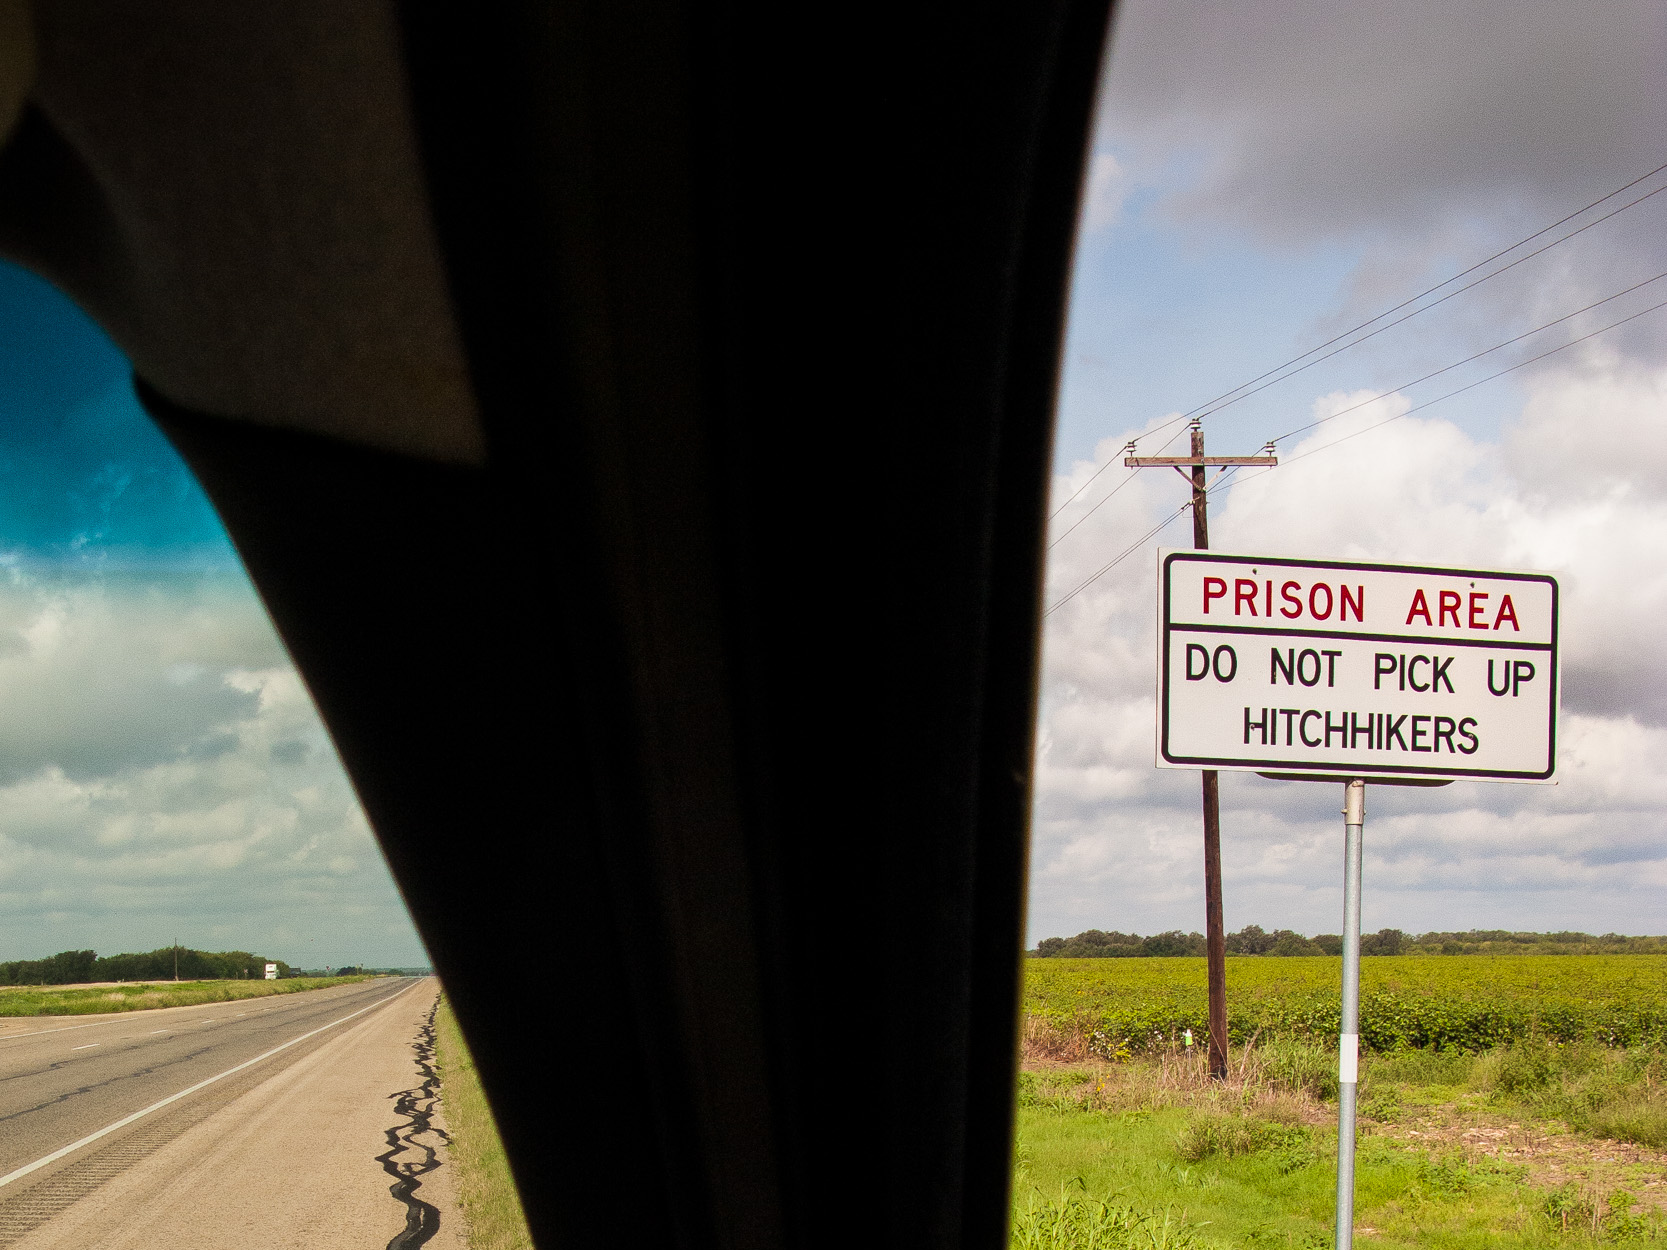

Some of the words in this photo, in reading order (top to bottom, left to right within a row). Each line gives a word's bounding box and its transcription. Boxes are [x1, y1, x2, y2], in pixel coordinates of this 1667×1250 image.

[1203, 576, 1364, 623] PRISON
[1406, 589, 1520, 632] AREA
[1186, 643, 1238, 683] DO
[1271, 648, 1342, 687] NOT
[1374, 653, 1455, 693] PICK
[1487, 659, 1536, 697] UP
[1244, 707, 1480, 755] HITCHHIKERS
